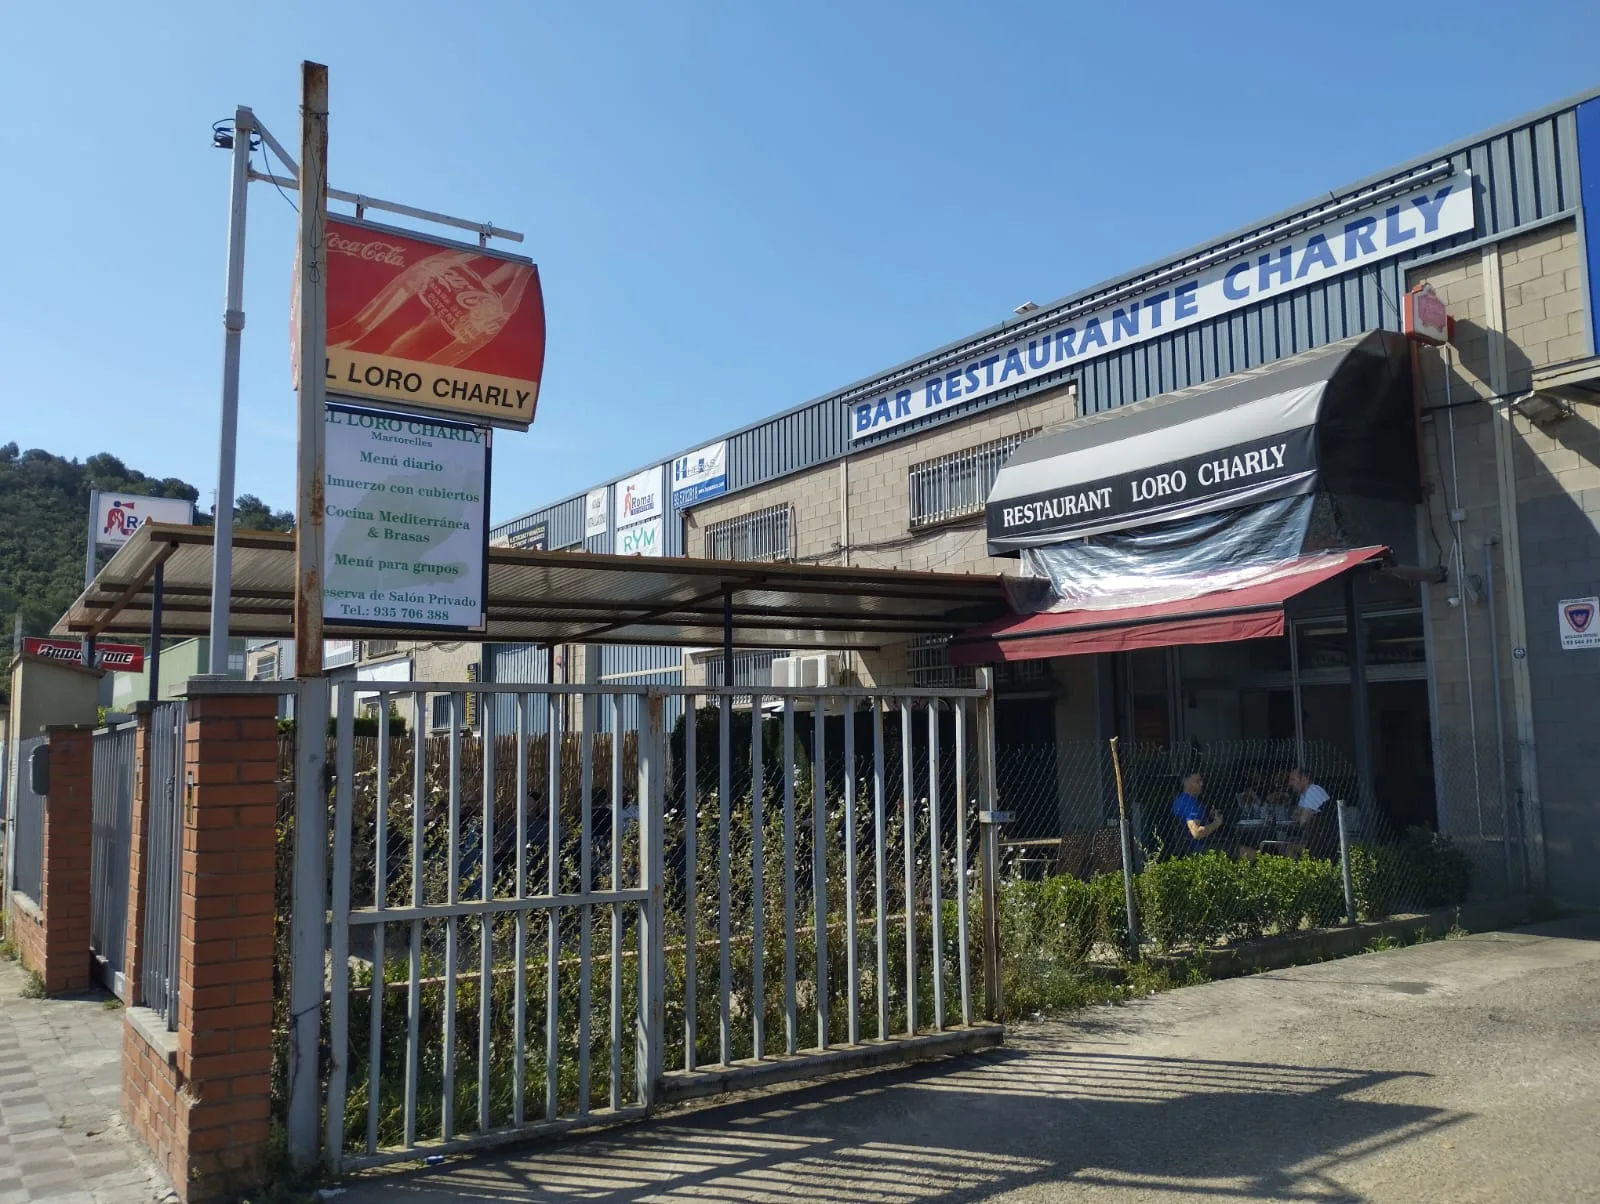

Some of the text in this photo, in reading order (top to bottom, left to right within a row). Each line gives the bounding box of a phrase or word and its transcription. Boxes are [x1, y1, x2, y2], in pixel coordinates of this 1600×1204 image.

[856, 184, 1454, 433] BAR RESTAURANTE CHARLY
[347, 362, 423, 393] LORO
[432, 377, 531, 409] CHARLY
[347, 413, 403, 432] LORO
[408, 422, 481, 444] CHARLY
[371, 430, 433, 448] Martorelles
[360, 450, 443, 472] Menú diario
[325, 474, 480, 503] lmuerzo con cubiertos
[1002, 443, 1287, 528] RESTAURANT LORO CHARLY
[631, 493, 654, 509] Romar
[326, 504, 470, 530] Cocina Mediterránea
[367, 526, 430, 543] & Brasas
[623, 527, 655, 552] RYM
[335, 553, 459, 576] Menú para grupos
[369, 589, 385, 601] de
[389, 591, 425, 604] Salón
[428, 594, 476, 607] Privado
[341, 603, 449, 621] Tel.: 935 706 388
